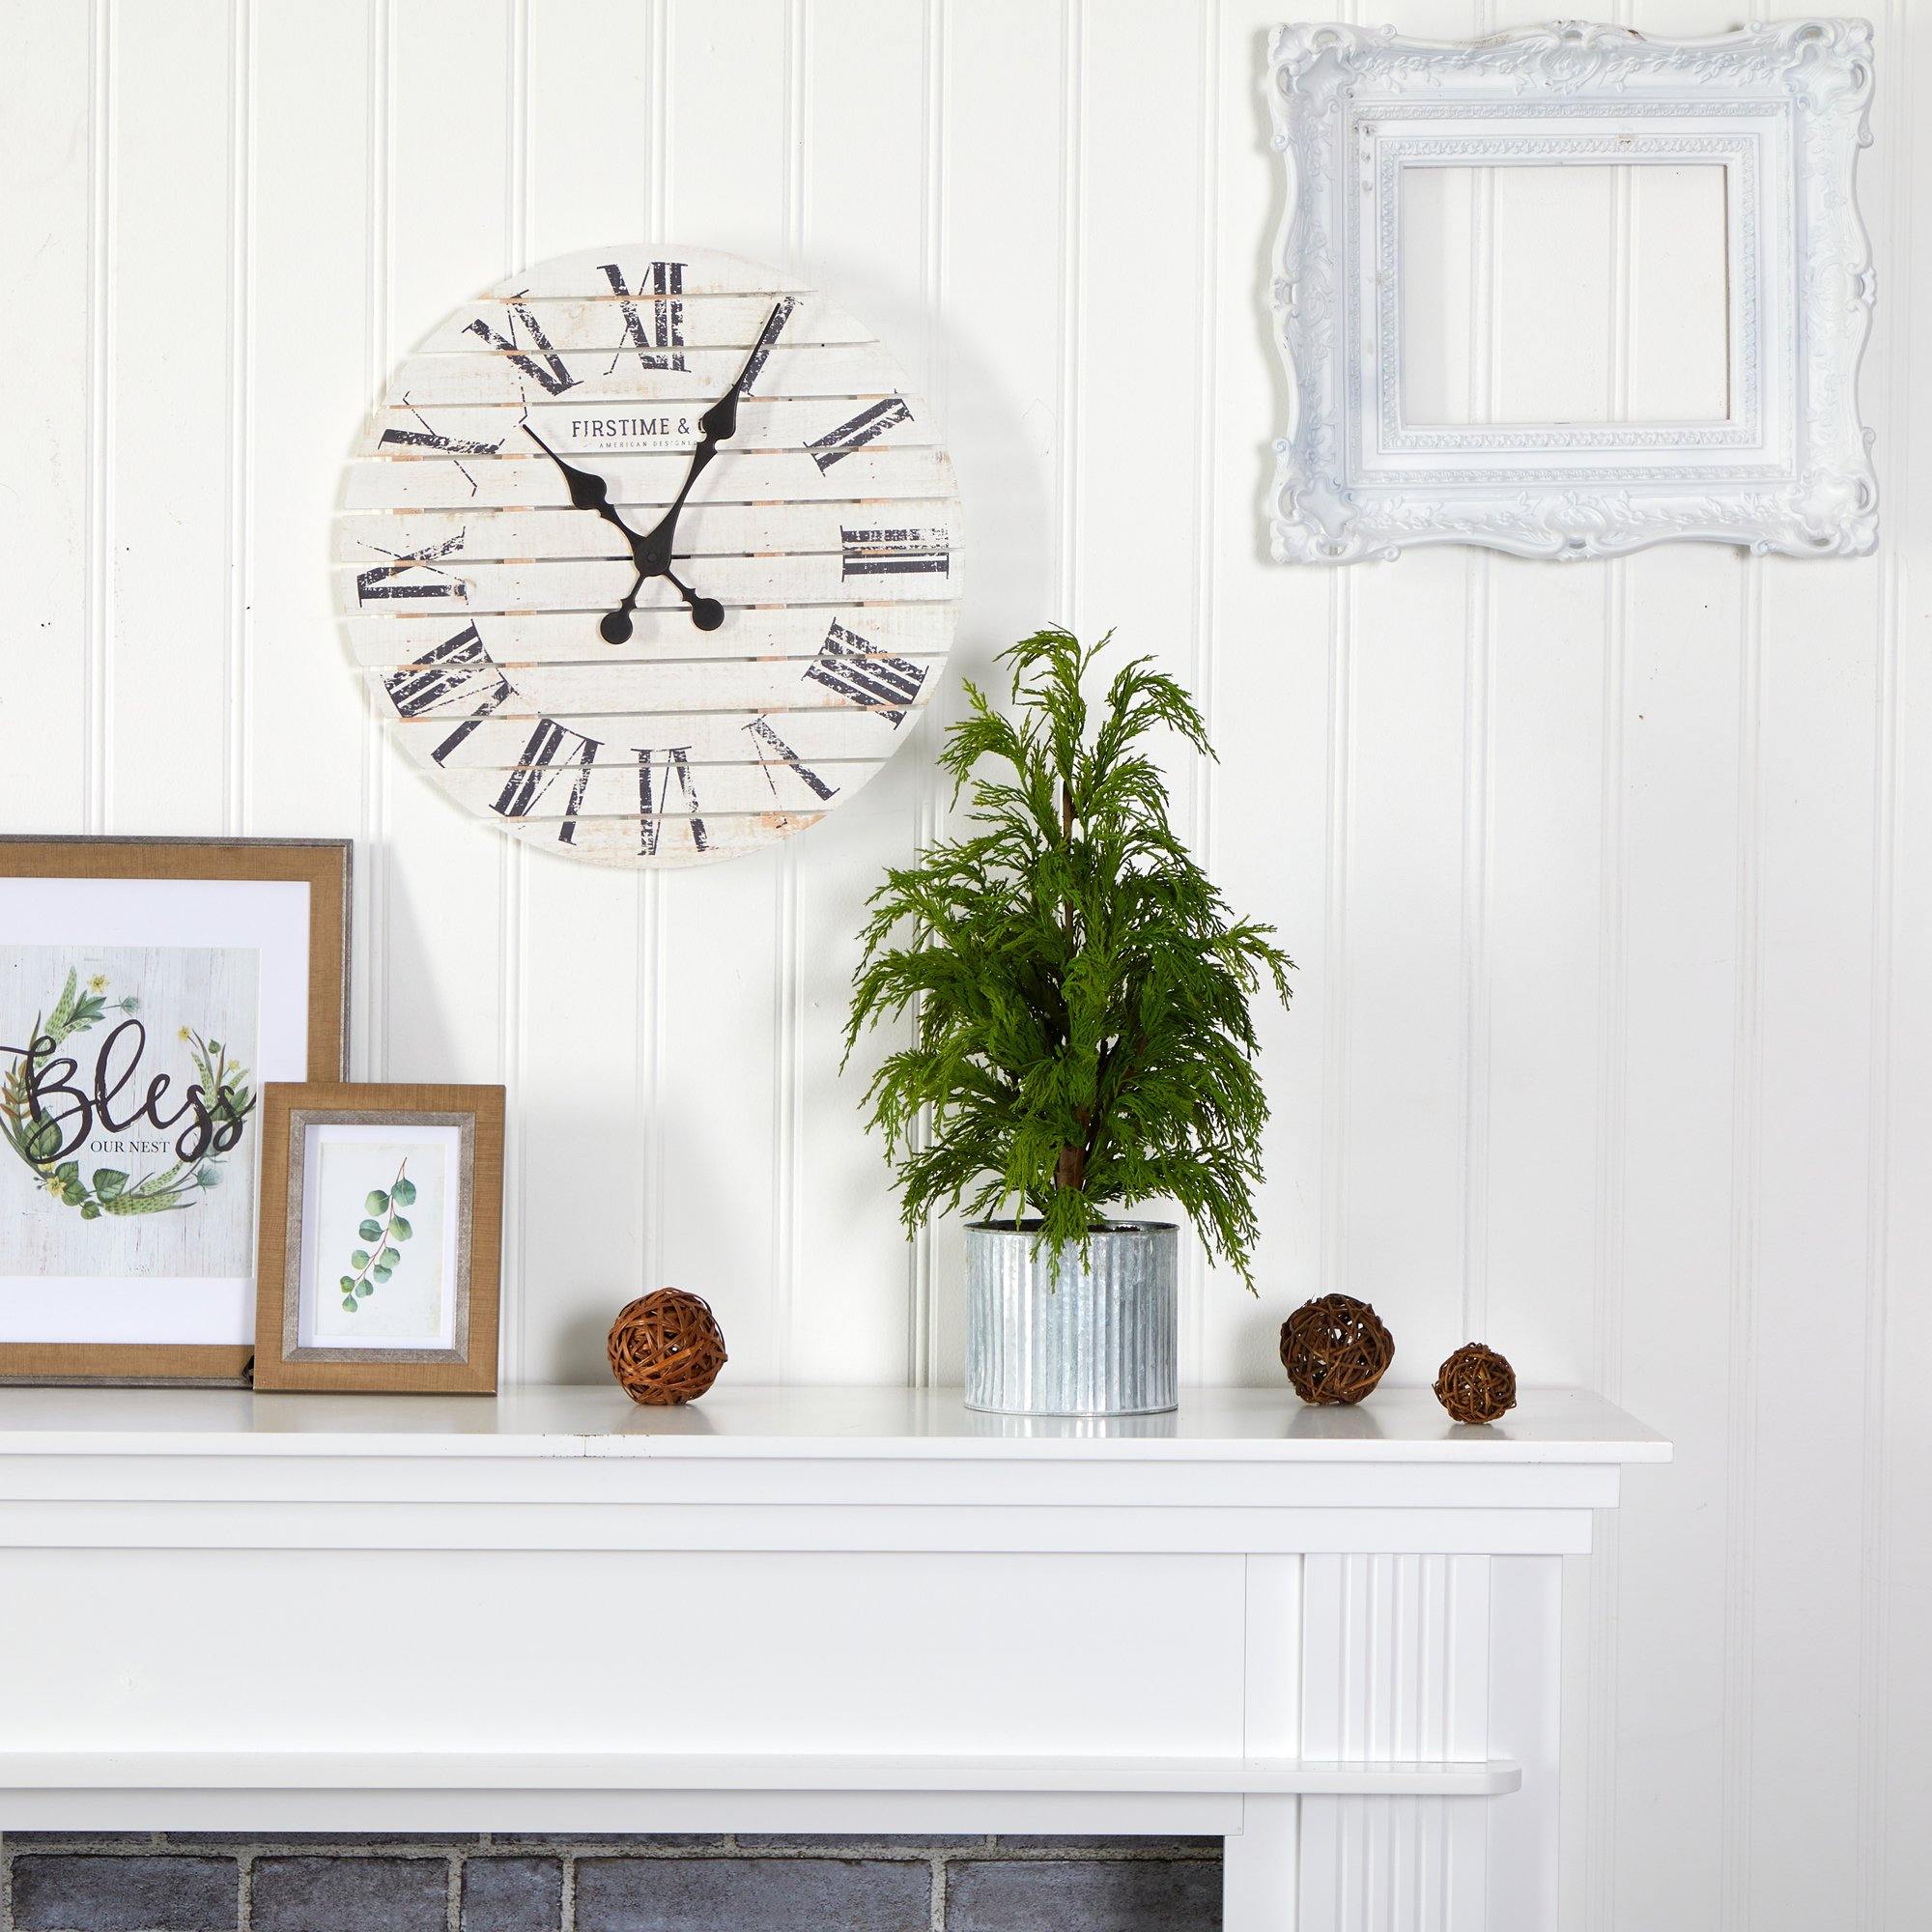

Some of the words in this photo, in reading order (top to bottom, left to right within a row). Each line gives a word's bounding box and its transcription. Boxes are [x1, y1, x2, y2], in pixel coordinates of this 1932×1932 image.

[597, 261, 692, 376] XII
[572, 417, 669, 438] FIRSTIME
[677, 417, 690, 435] &
[803, 388, 915, 477] II
[839, 525, 950, 582] III
[0, 1019, 257, 1165] Bless
[90, 1140, 125, 1153] OUR
[128, 1140, 170, 1153] NEST
